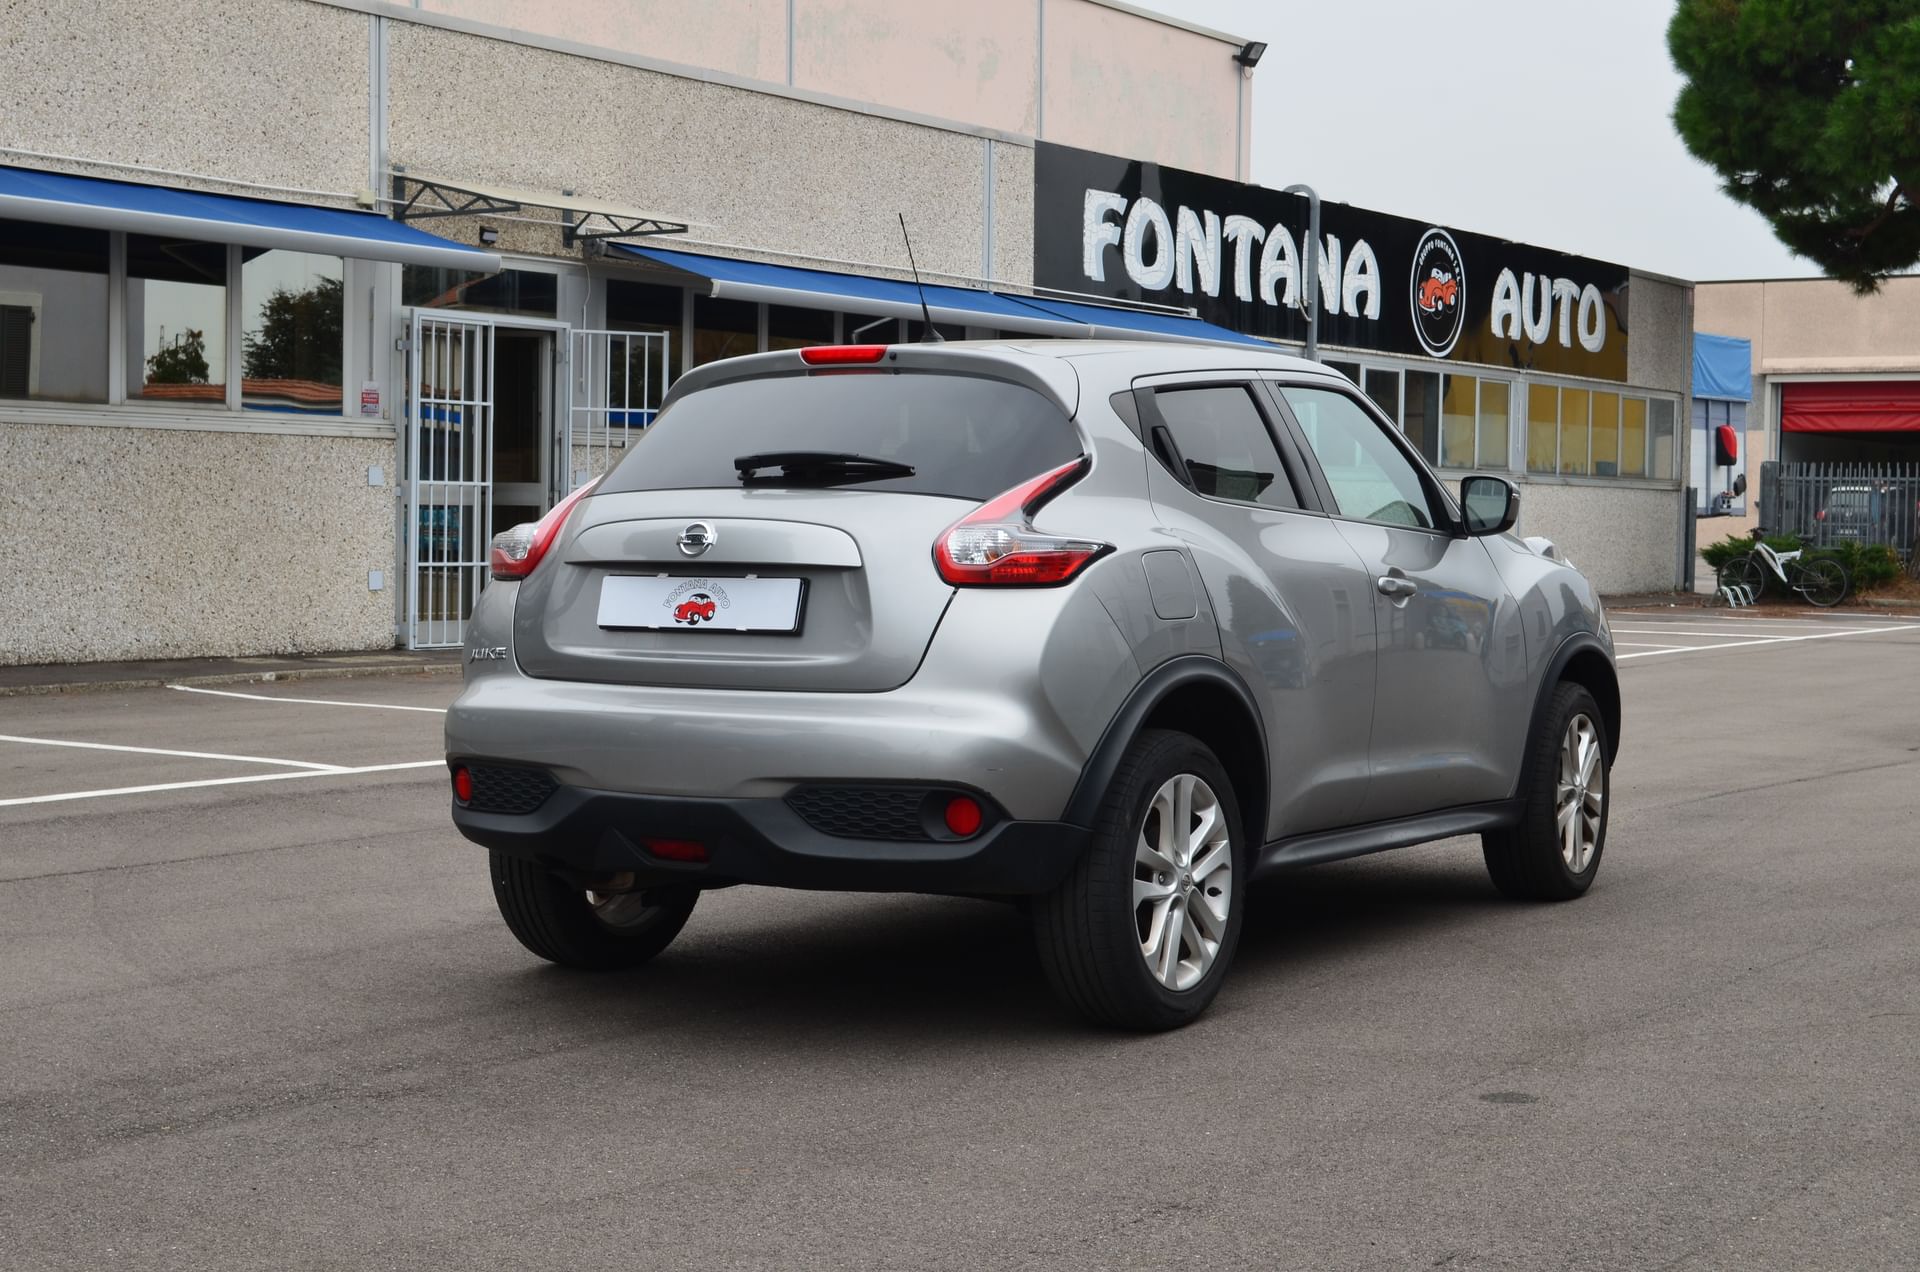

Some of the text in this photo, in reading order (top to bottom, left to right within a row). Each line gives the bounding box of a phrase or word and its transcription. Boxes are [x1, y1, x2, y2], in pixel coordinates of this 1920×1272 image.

[1418, 240, 1434, 266] GRUPPO
[1434, 239, 1454, 261] FONTANA
[1083, 188, 1606, 353] FONTANA AUTO
[662, 578, 731, 609] FONTANA AUTO
[468, 646, 508, 664] JUKE
